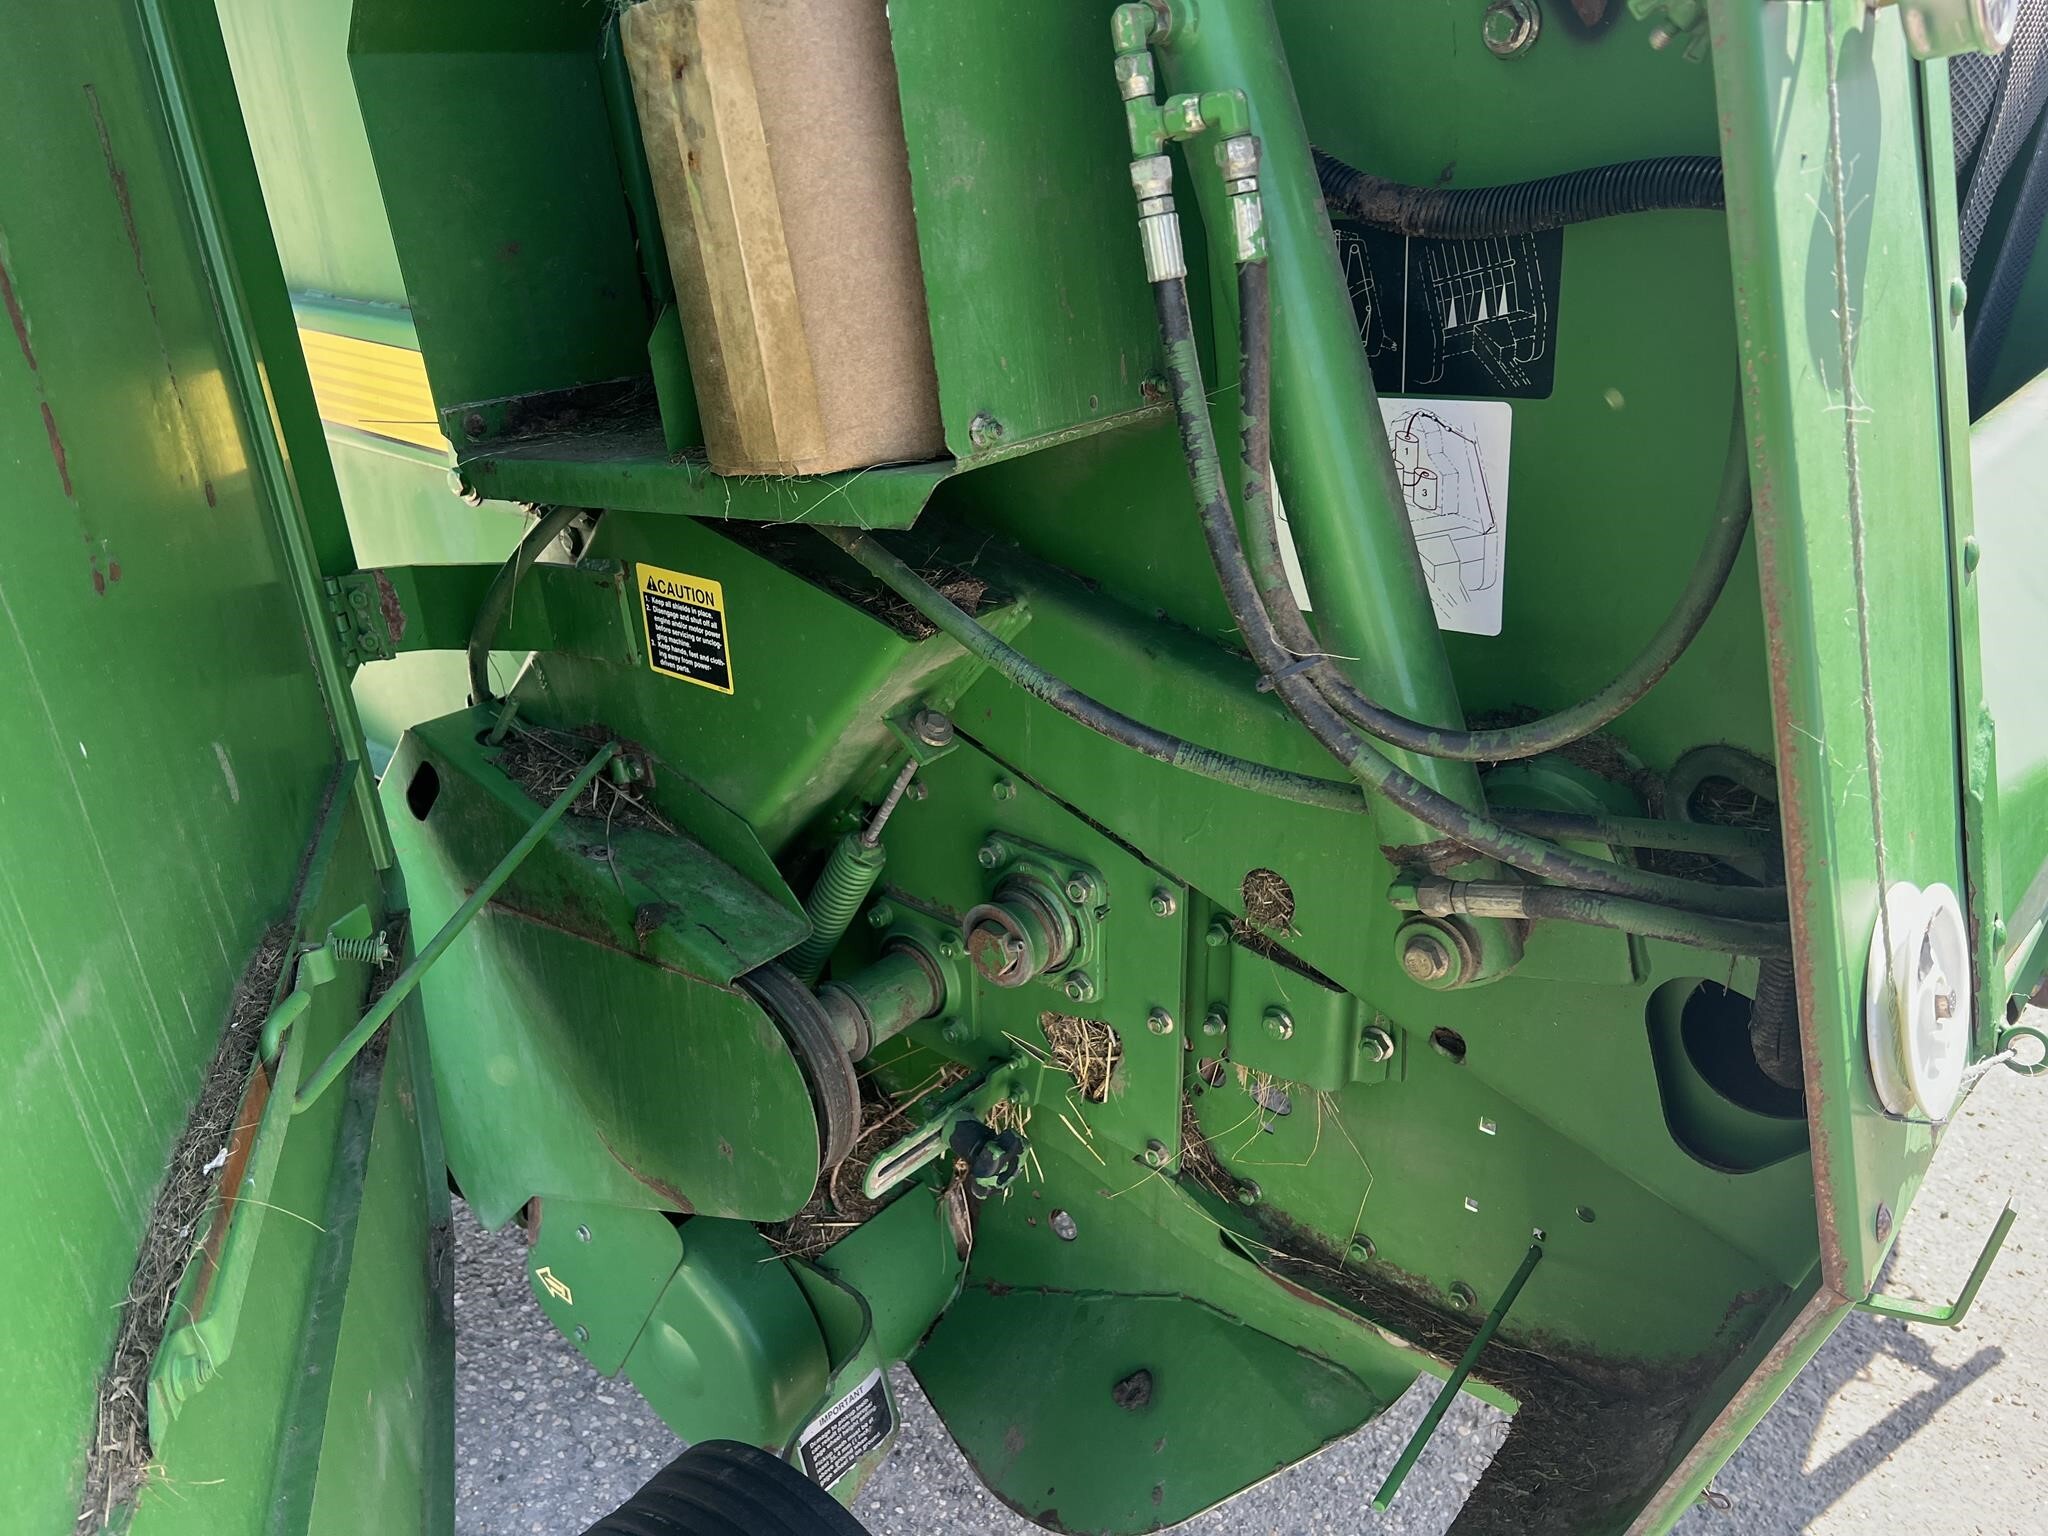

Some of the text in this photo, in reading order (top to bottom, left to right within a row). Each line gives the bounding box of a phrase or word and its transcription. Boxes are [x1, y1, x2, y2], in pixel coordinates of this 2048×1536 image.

[658, 580, 714, 606] CAUTION
[652, 597, 664, 606] Keep
[672, 603, 690, 613] shields
[698, 610, 713, 619] place.
[653, 606, 679, 619] Disengage
[690, 617, 702, 625] shut
[654, 616, 720, 639] engine and/or motor power
[655, 624, 671, 634] before
[672, 630, 695, 642] servicing
[702, 638, 722, 649] unclog-
[657, 634, 691, 648] ging machine.
[658, 641, 670, 651] Keep
[671, 645, 688, 656] hands,
[689, 650, 699, 659] feet
[700, 654, 709, 662] and
[710, 657, 725, 666] cloth-
[659, 650, 711, 671] ing away from power-
[660, 659, 691, 673] driven parts.
[819, 1386, 864, 1426] IMPORTANT
[810, 1430, 831, 1448] Damage
[838, 1410, 856, 1426] pickup
[812, 1401, 872, 1454] can result from improper
[813, 1448, 826, 1462] gage
[827, 1433, 842, 1448] wheel
[842, 1420, 859, 1436] height
[815, 1452, 833, 1468] Pickup
[833, 1440, 847, 1453] teeth
[847, 1428, 861, 1441] must
[817, 1461, 829, 1474] least
[841, 1443, 852, 1453] mm
[819, 1437, 867, 1480] above ground when
[820, 1473, 833, 1487] gage
[833, 1458, 848, 1474] wheel
